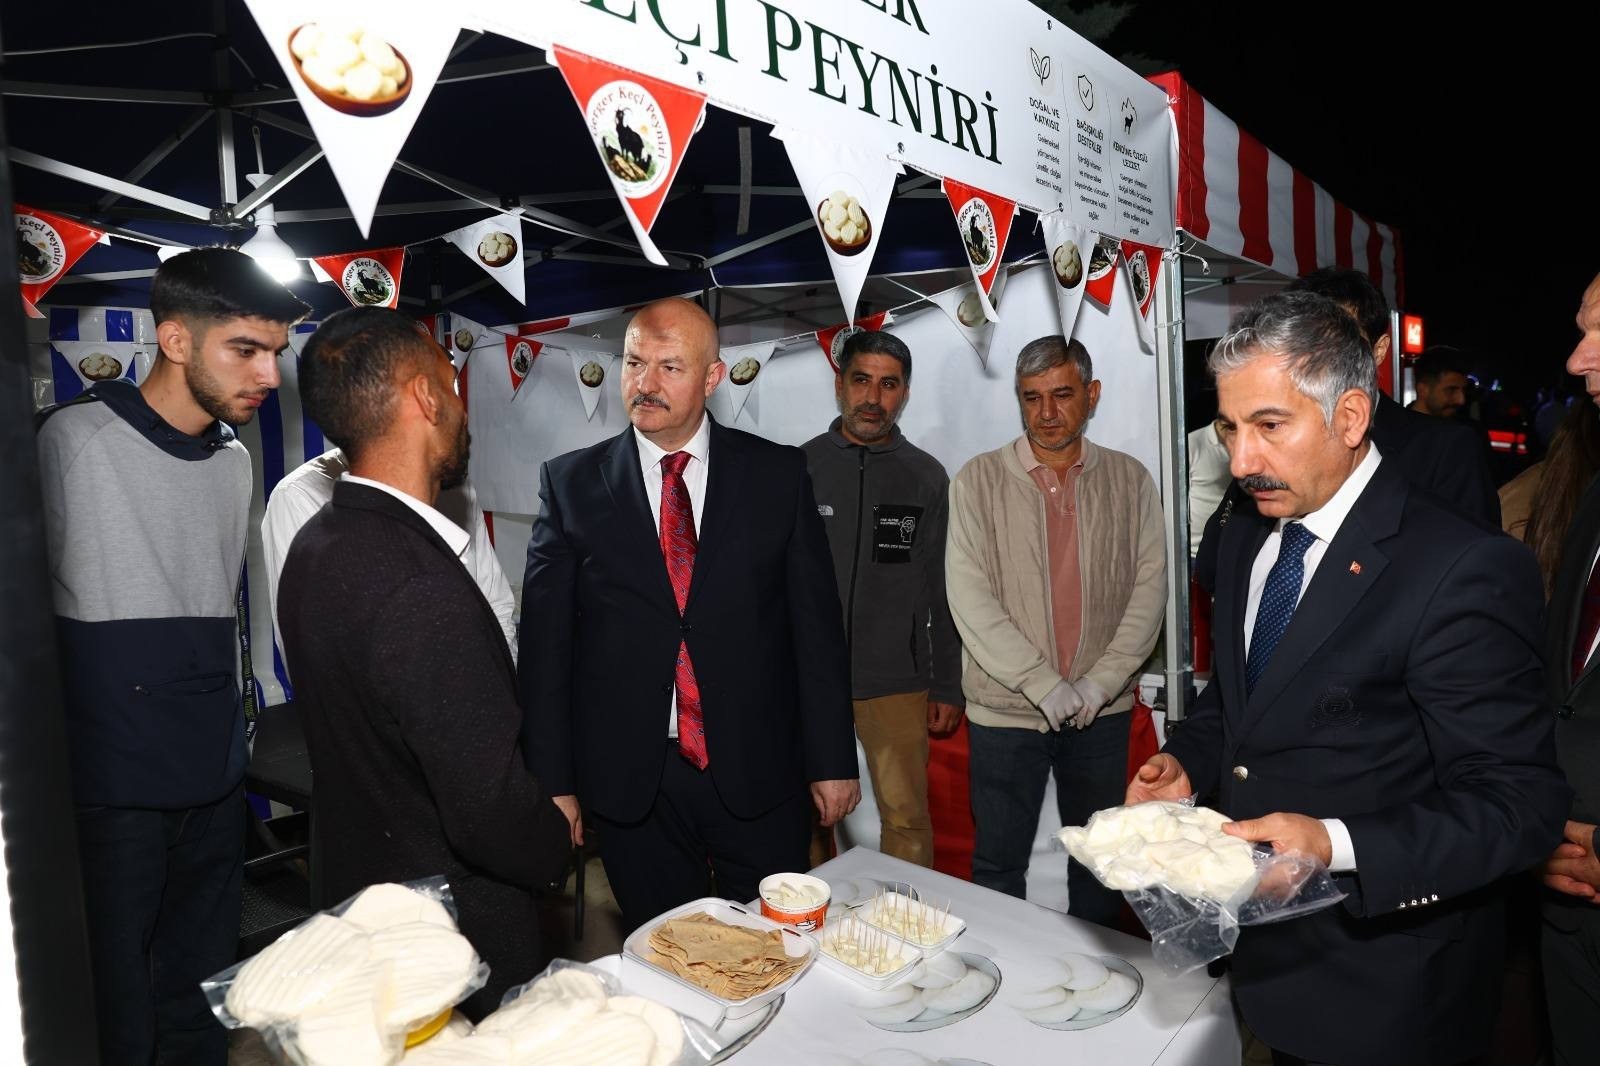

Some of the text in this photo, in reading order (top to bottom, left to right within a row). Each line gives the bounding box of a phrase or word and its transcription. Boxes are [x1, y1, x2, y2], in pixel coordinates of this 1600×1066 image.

[757, 0, 1002, 165] PEYNİRİ
[1033, 112, 1060, 132] KATKISIZ
[1052, 107, 1060, 118] VE
[19, 217, 63, 265] Keçi Peyniri
